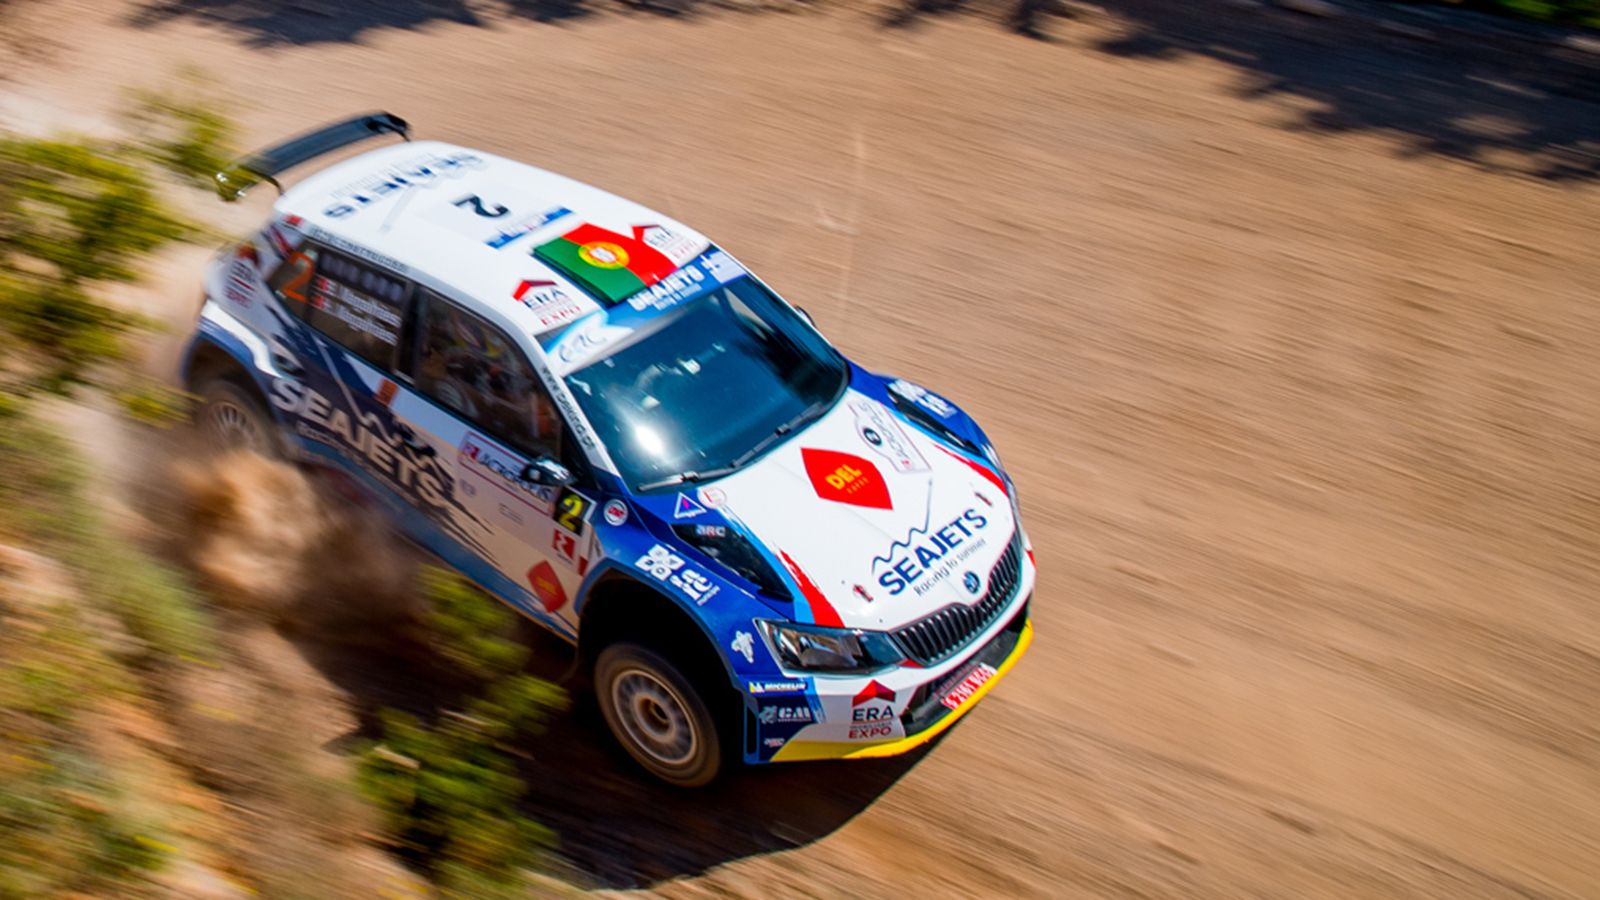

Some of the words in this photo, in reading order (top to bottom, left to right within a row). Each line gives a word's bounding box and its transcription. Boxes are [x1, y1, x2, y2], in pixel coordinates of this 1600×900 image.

[451, 193, 509, 218] 2
[281, 252, 316, 304] 2
[269, 376, 453, 510] SEAJETS
[824, 463, 862, 490] DEL
[558, 493, 584, 531] 2
[878, 508, 988, 596] SEAJETS
[913, 567, 950, 597] Racing
[853, 705, 894, 721] ERA
[848, 726, 892, 739] EXPO
